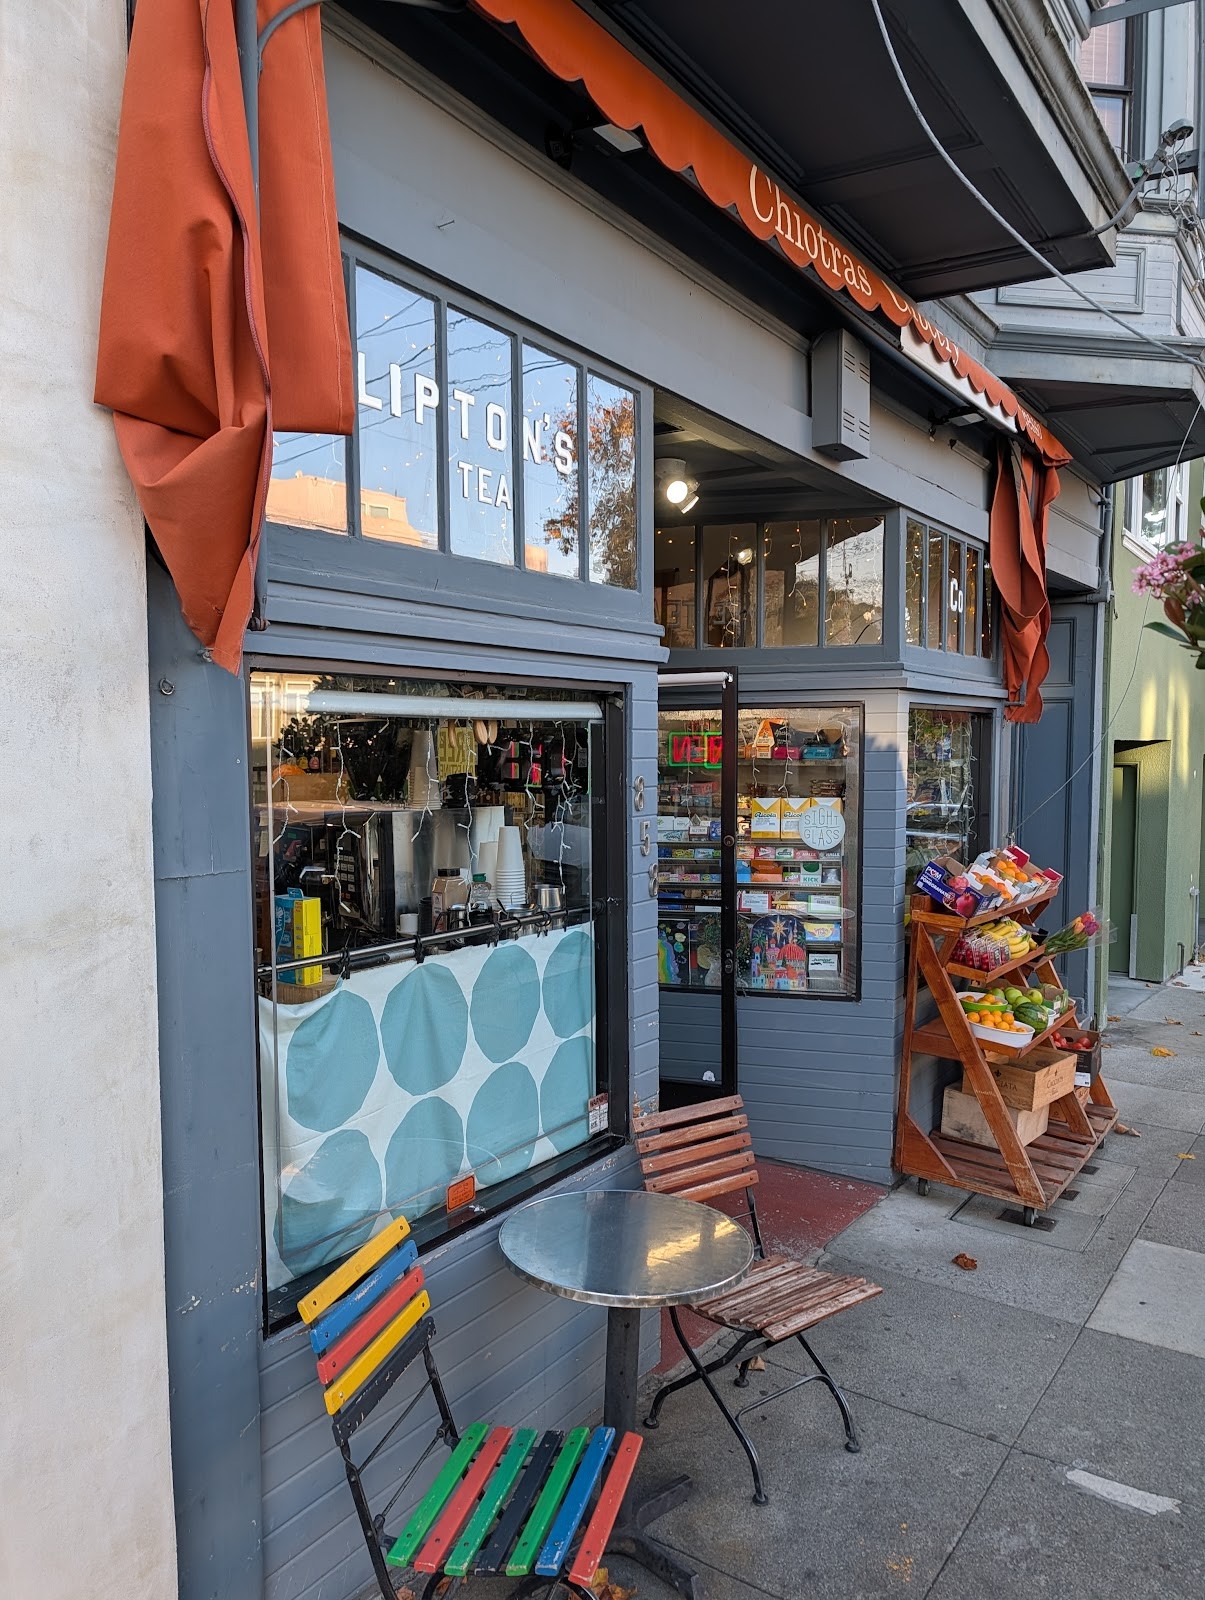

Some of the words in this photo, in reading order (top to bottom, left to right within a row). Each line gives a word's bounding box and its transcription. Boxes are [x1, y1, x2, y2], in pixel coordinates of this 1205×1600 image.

[749, 164, 872, 296] Chiotras
[357, 351, 574, 475] LIPTON'S
[458, 461, 512, 511] TEA
[804, 807, 839, 826] SIGHT
[804, 829, 840, 847] GLASS
